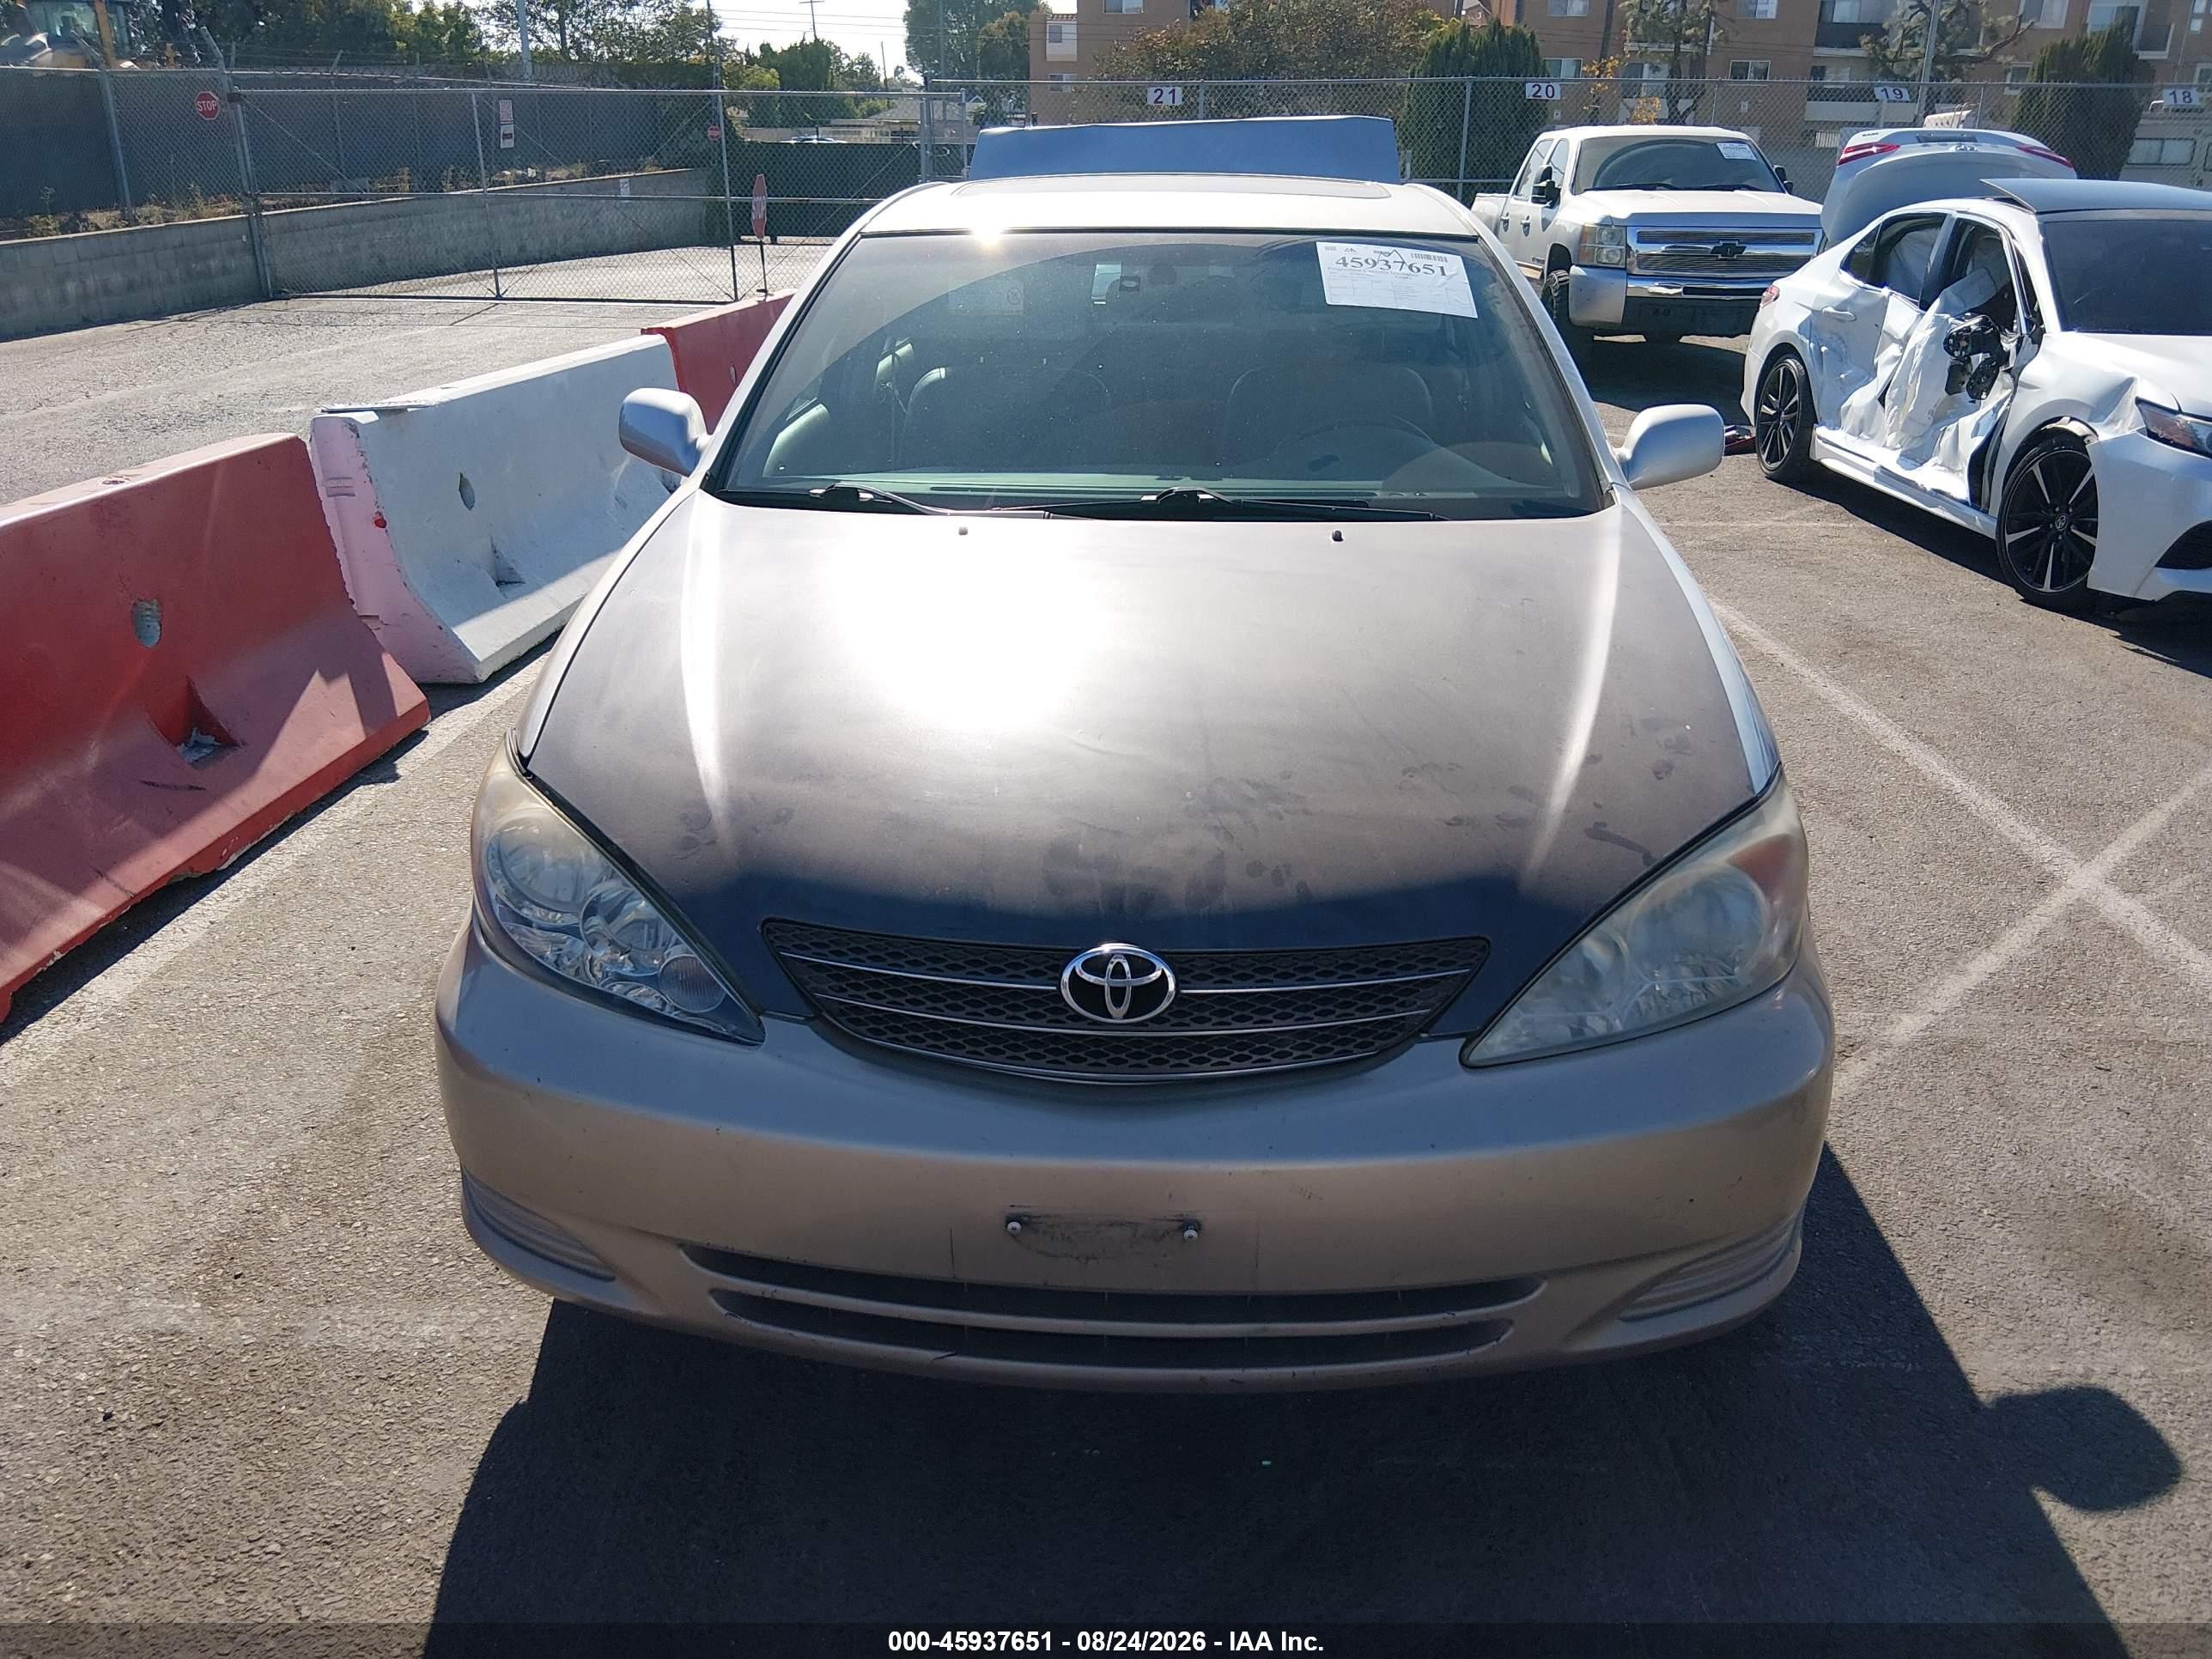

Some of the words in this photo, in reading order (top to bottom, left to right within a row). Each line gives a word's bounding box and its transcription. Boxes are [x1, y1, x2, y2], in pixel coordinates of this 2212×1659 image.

[1153, 88, 1176, 104] 21
[1532, 83, 1555, 99] 20
[1881, 88, 1904, 100] 19
[2169, 90, 2192, 104] 18
[198, 100, 217, 112] STOP
[1335, 256, 1449, 276] 45937651
